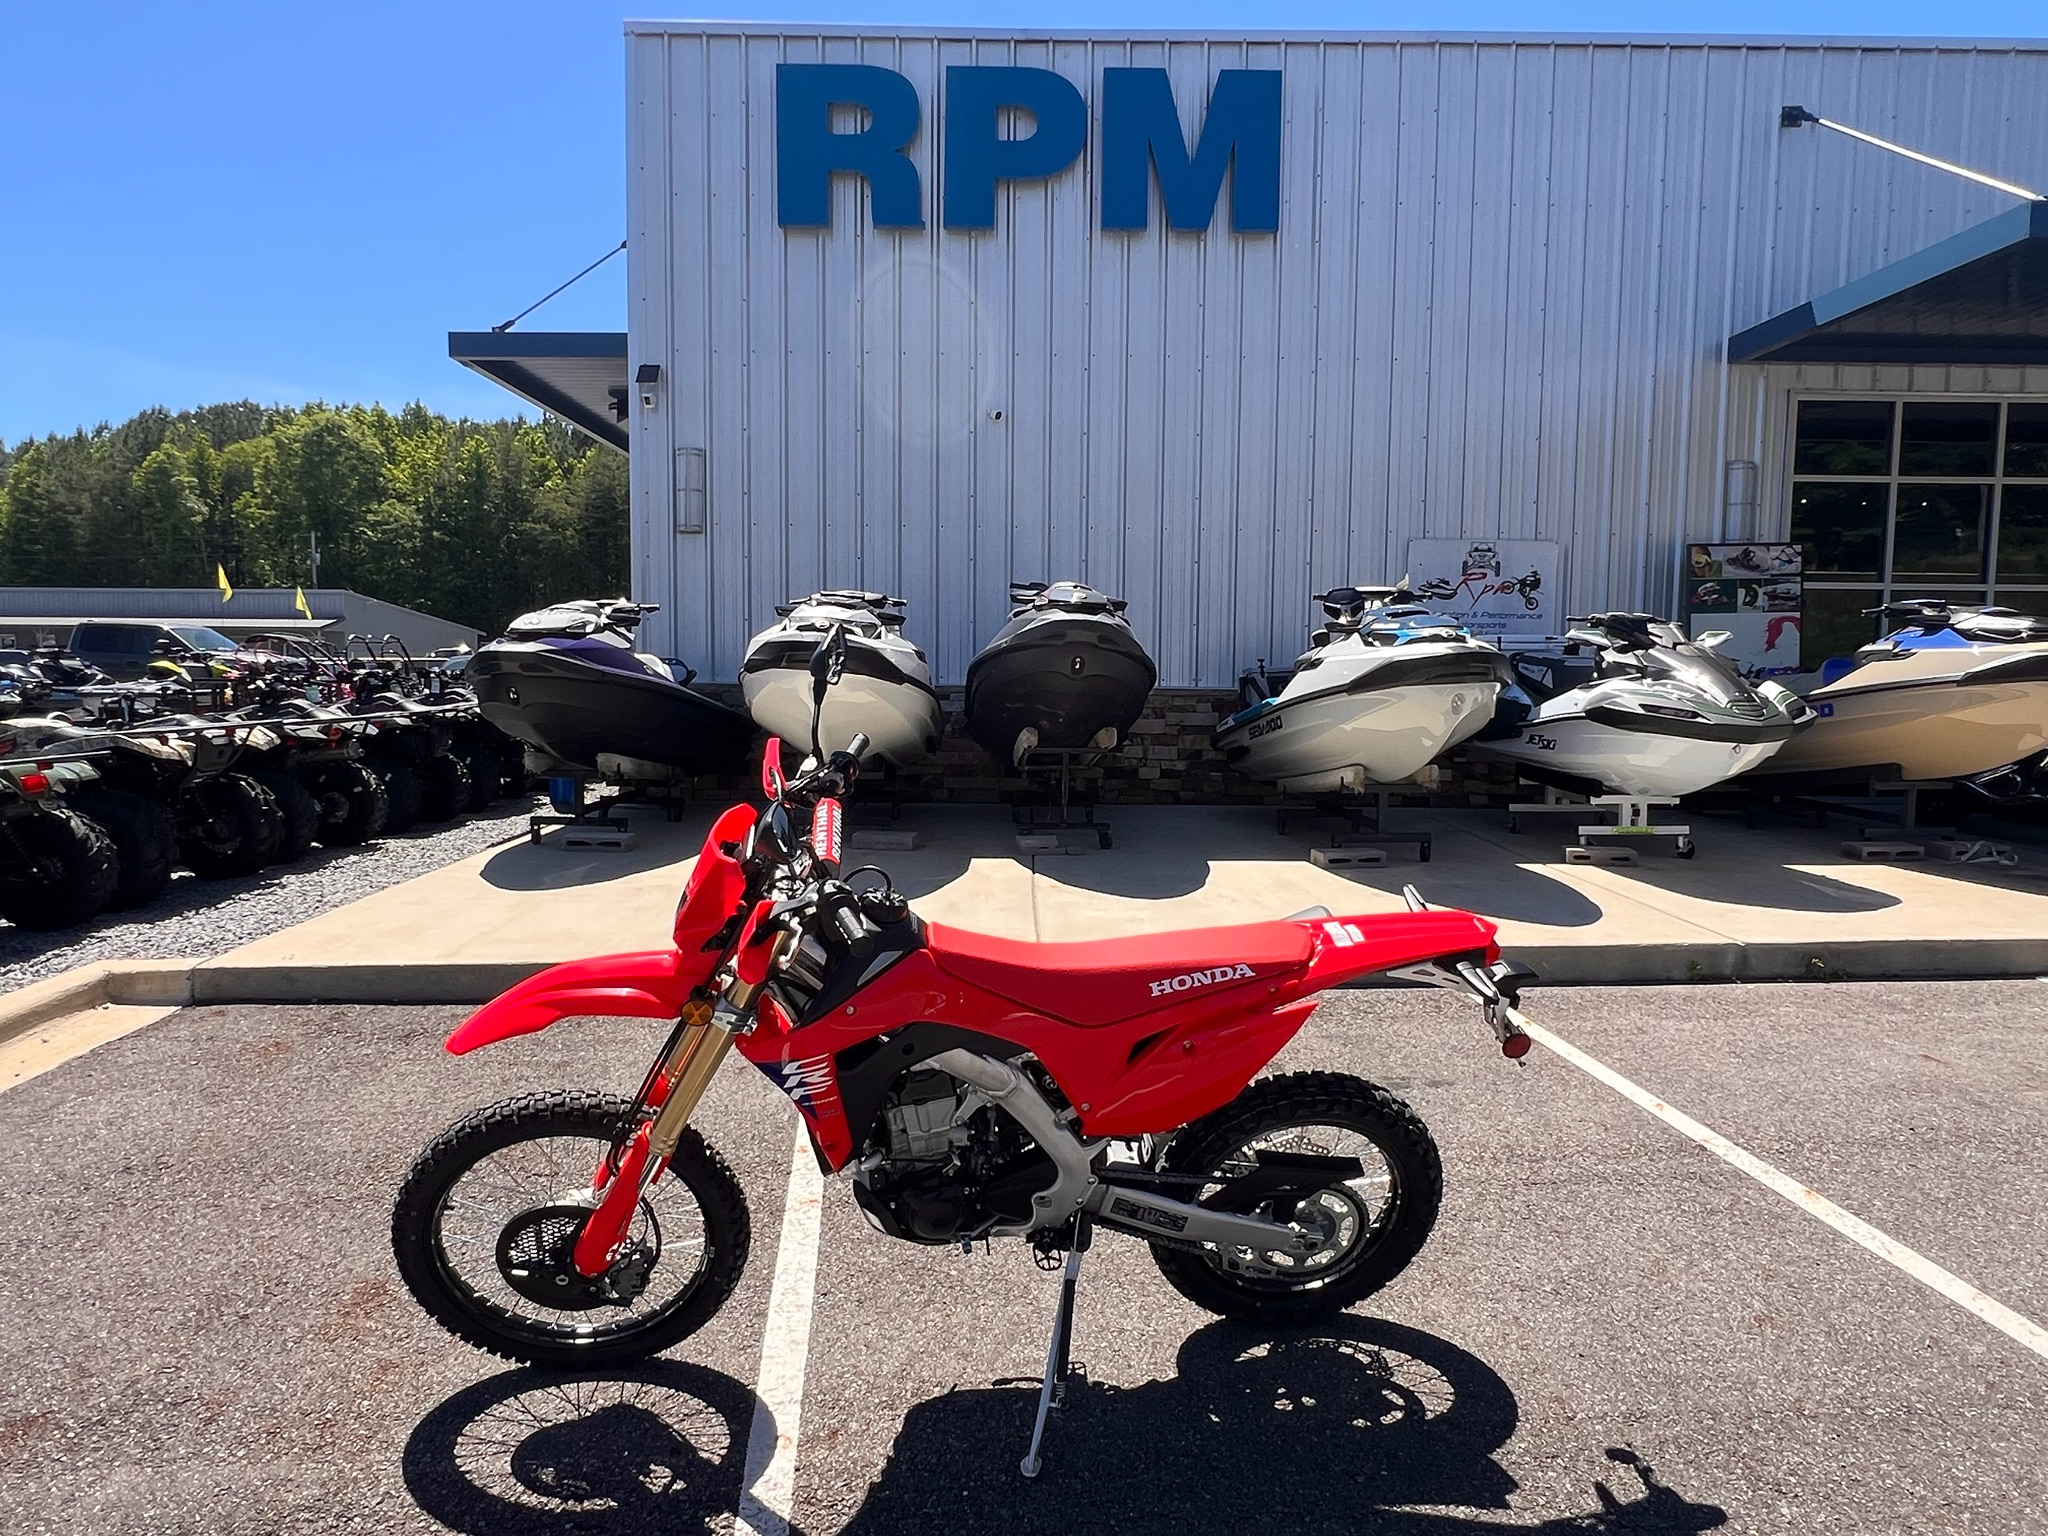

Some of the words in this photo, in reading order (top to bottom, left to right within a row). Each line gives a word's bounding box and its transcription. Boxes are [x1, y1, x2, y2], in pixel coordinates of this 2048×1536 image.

[776, 63, 1283, 233] RPM
[1471, 611, 1478, 619] &
[1480, 611, 1543, 620] Performance
[815, 802, 828, 856] RENTHAL
[832, 805, 842, 860] RENTHAL
[1148, 963, 1256, 997] HONDA
[781, 1053, 834, 1101] CRF
